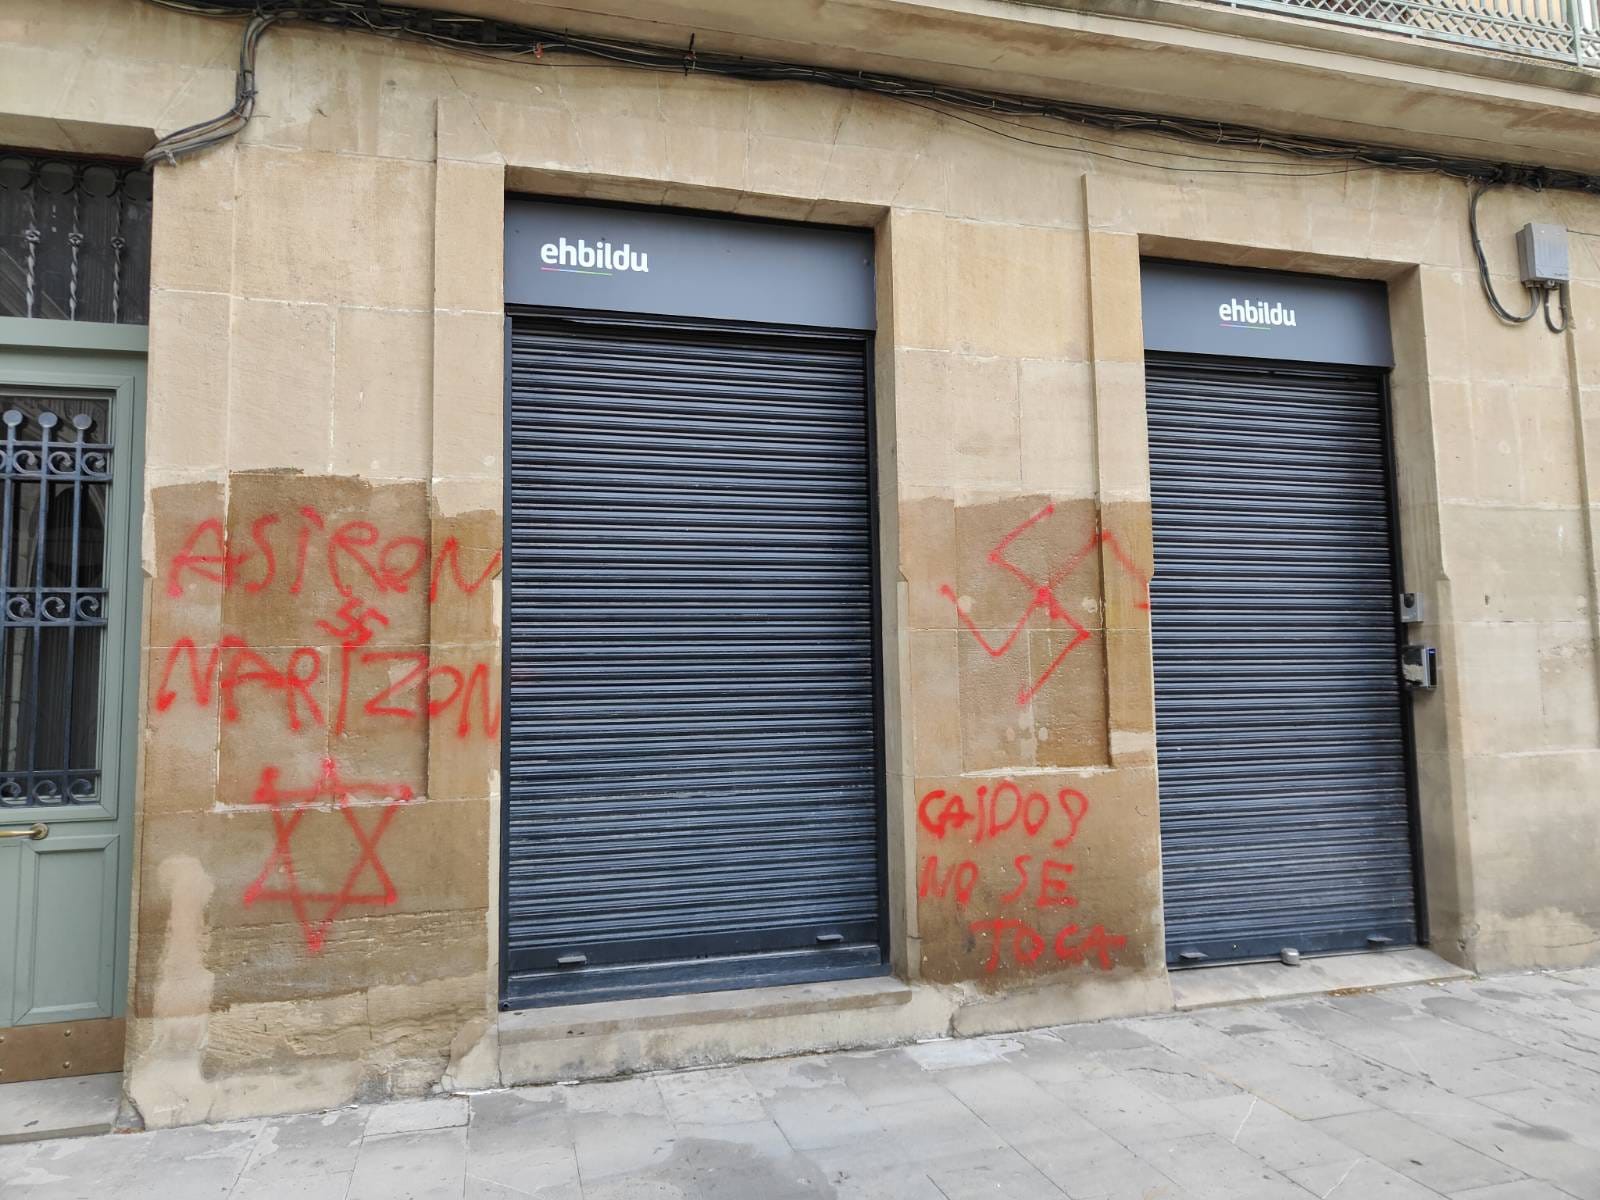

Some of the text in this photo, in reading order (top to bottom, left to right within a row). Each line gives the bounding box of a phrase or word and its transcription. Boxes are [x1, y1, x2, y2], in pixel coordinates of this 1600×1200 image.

[540, 237, 649, 273] ehbildu
[1218, 298, 1298, 327] ehbildu
[155, 636, 502, 739] NARIZON
[918, 854, 1078, 908] NO SE
[969, 917, 1128, 973] TOCA
